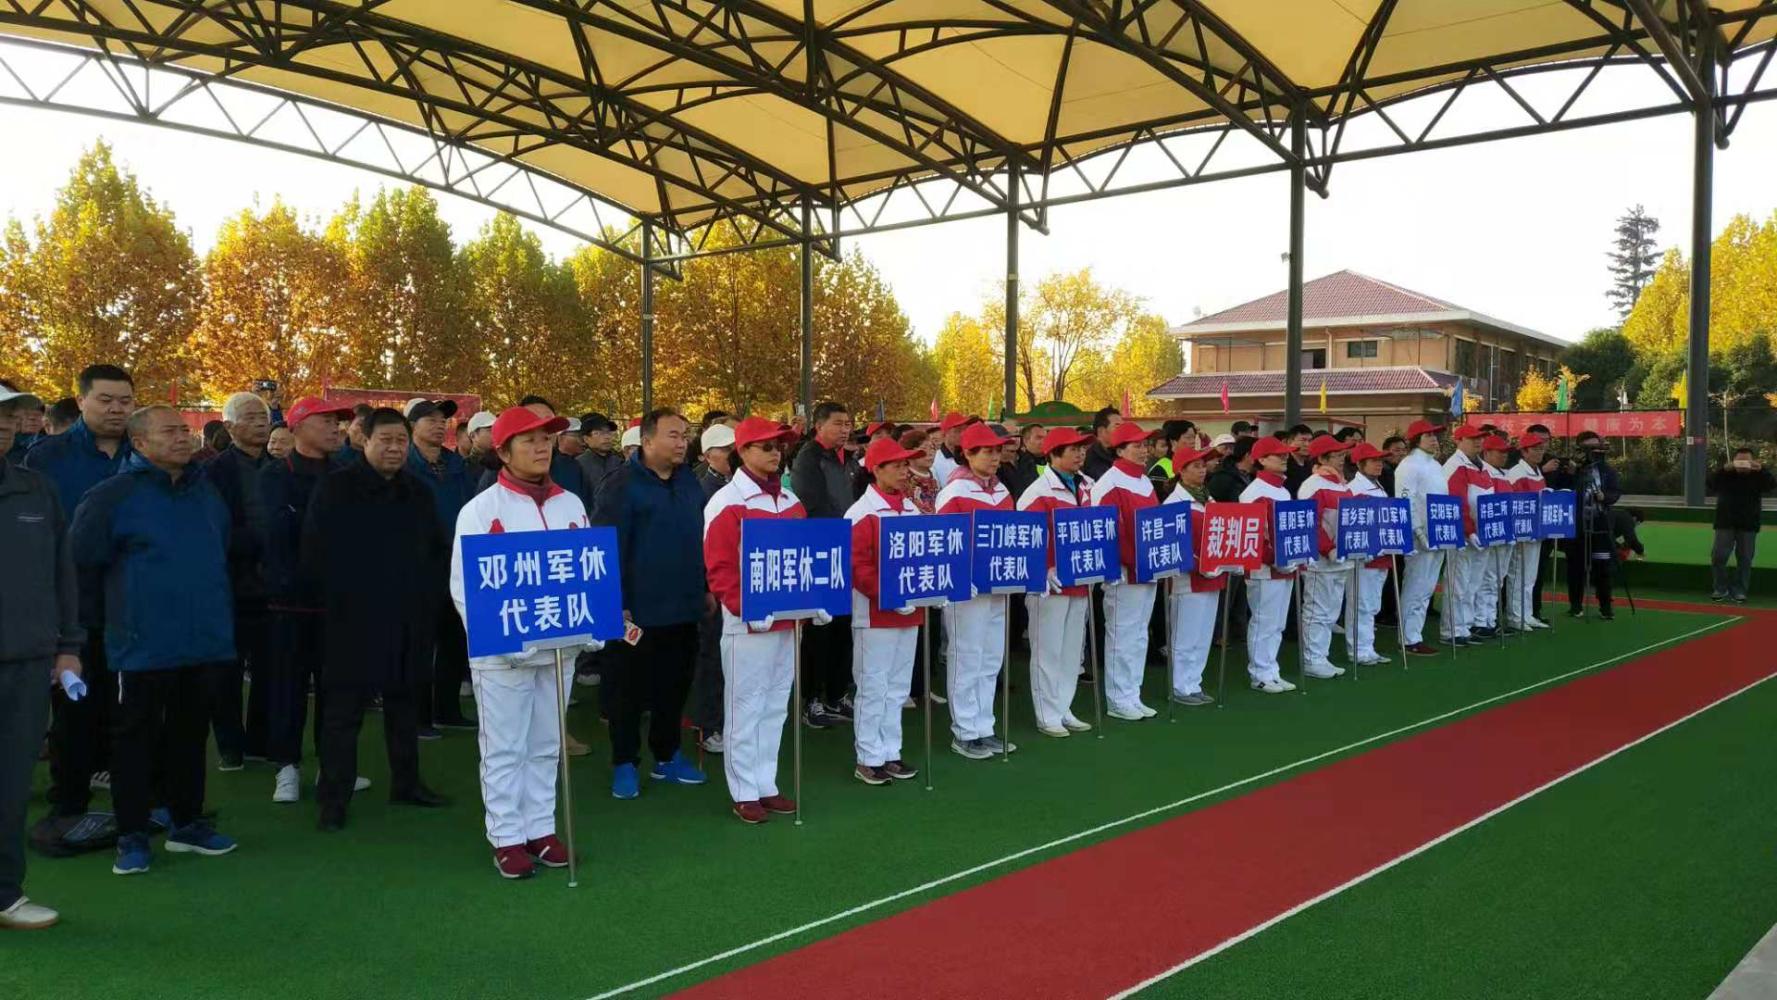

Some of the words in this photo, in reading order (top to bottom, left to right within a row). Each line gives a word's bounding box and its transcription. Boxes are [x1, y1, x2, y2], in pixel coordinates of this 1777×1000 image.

[1341, 507, 1375, 526] 新乡军休
[1378, 506, 1408, 524] 口军休
[1430, 503, 1460, 521] 安阳军休
[977, 523, 1043, 548] 三门峡军休
[1057, 517, 1116, 544] 平顶山军休
[1141, 513, 1187, 542] 许昌一所
[1207, 516, 1260, 559] 裁判员
[1379, 527, 1405, 546] 代表队
[1435, 524, 1458, 541] 代表队
[1484, 521, 1506, 539] 代表队
[1514, 518, 1533, 534] 代表队
[889, 527, 963, 559] 洛阳军休
[1284, 535, 1311, 557] 代表队
[1345, 531, 1370, 550] 代表队
[478, 546, 606, 590] 邓州军休
[990, 555, 1029, 582] 代表队
[1071, 548, 1106, 574] 代表队
[1148, 541, 1182, 570] 代表队
[750, 546, 845, 594] 南阳军休二队
[899, 563, 953, 595] 代表队
[500, 592, 595, 636] 代表队
